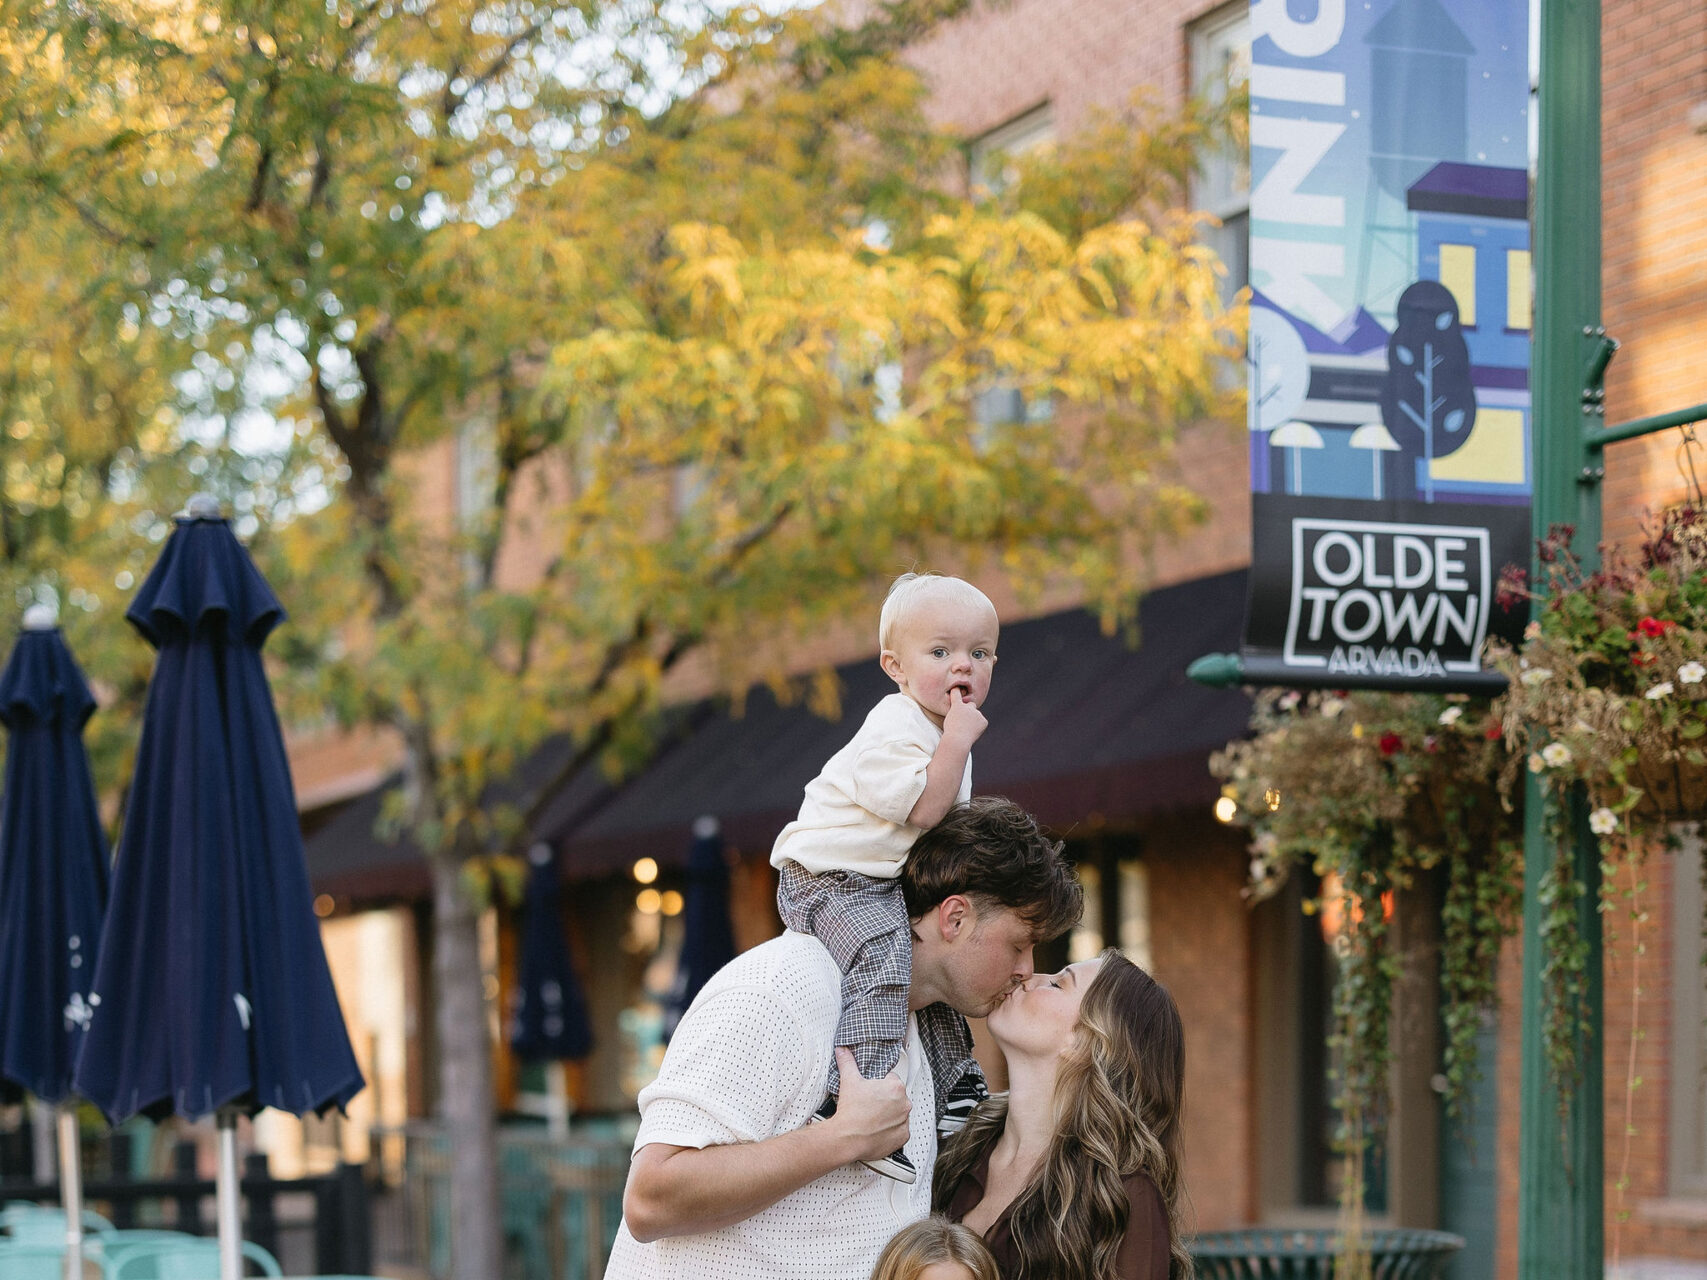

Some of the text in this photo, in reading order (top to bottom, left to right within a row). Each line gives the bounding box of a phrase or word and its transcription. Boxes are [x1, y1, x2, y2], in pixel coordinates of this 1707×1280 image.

[1312, 531, 1469, 592] OLDE
[1302, 586, 1479, 646] TOWN
[1327, 644, 1448, 678] ARVADA
